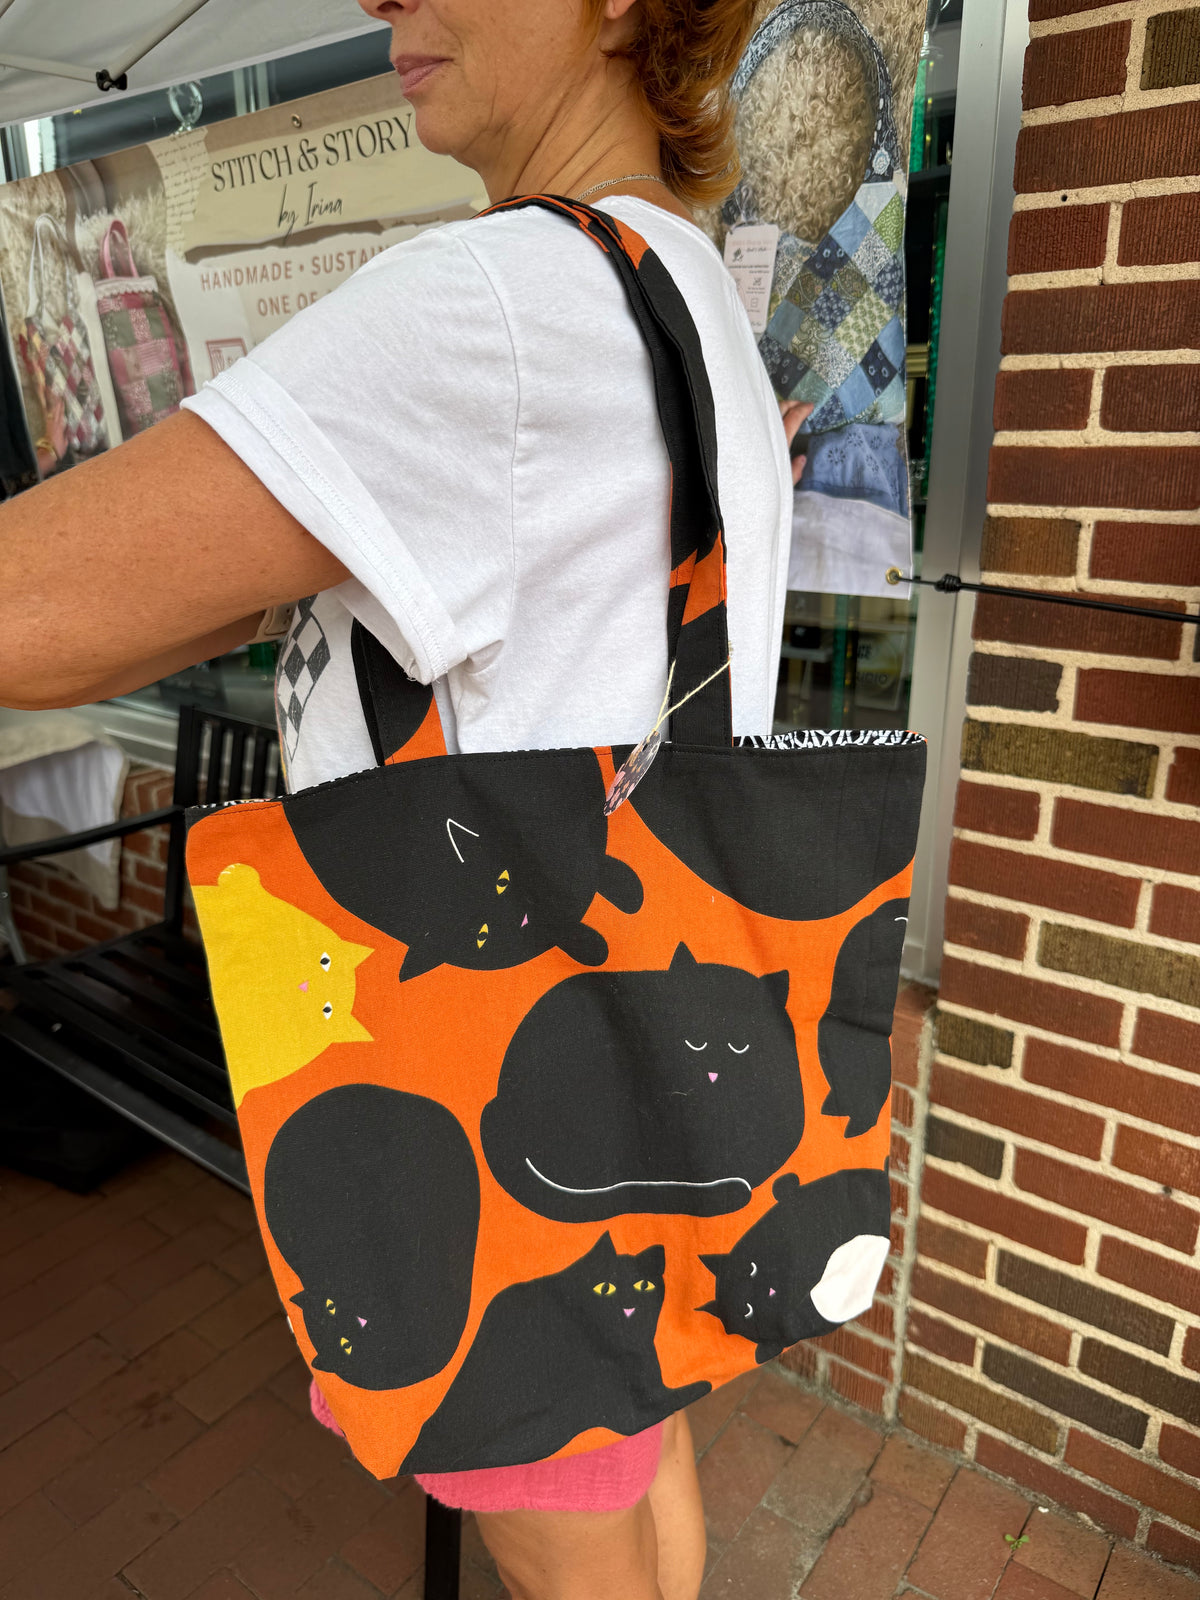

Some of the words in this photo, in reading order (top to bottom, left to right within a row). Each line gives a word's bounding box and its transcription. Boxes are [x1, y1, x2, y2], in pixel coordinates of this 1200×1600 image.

[211, 145, 292, 192] STITCH
[298, 138, 319, 173] &
[322, 112, 413, 167] STORY
[277, 183, 299, 246] by
[304, 182, 343, 226] Irina
[200, 260, 293, 292] HANDMADE
[257, 295, 292, 317] ONE
